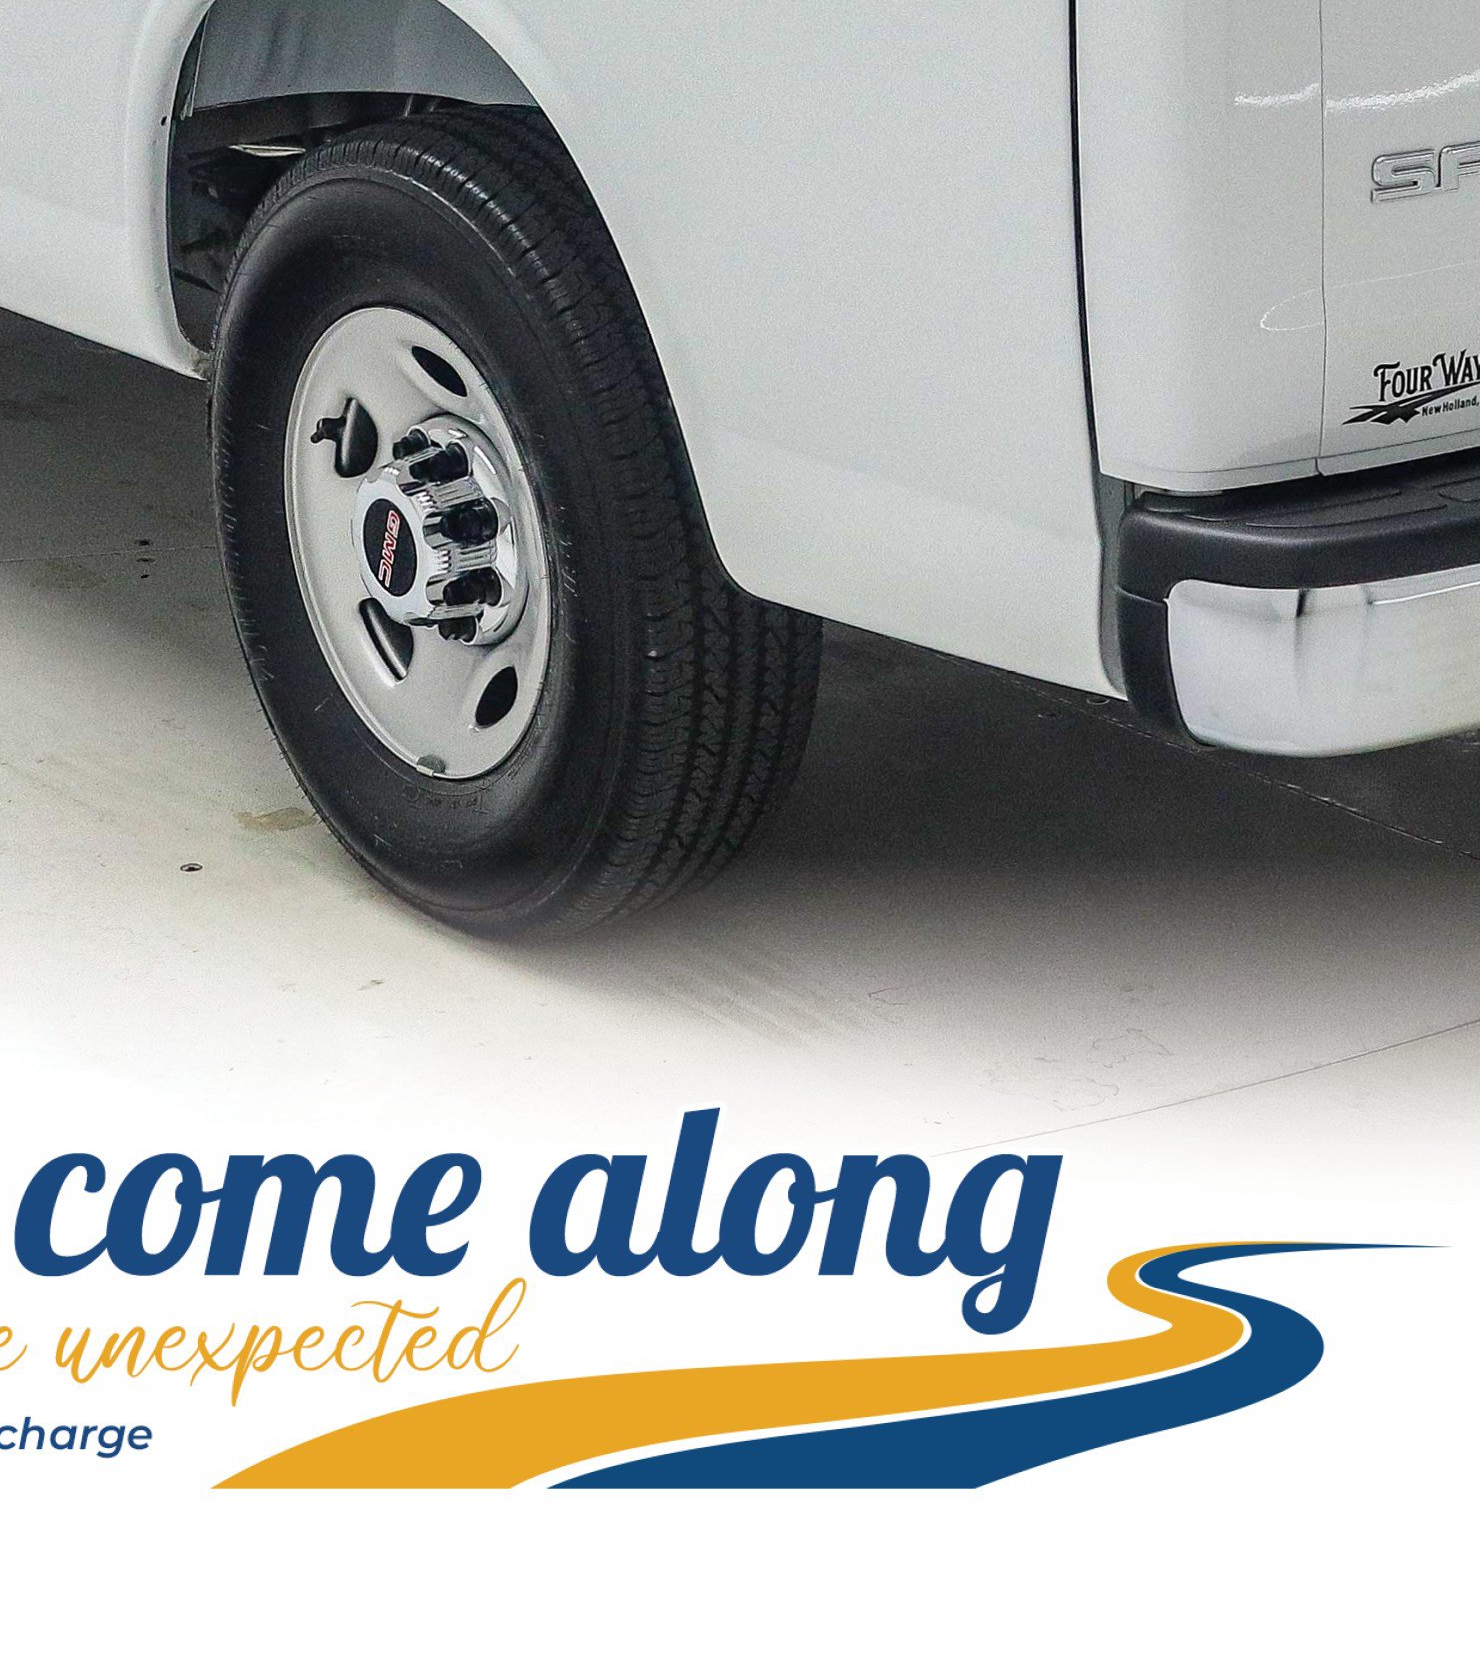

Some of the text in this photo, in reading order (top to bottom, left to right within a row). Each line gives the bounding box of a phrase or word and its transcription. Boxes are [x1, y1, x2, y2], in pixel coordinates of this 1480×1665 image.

[1373, 361, 1432, 402] FOUR
[1422, 406, 1441, 416] New
[1442, 395, 1479, 412] Holland,
[378, 510, 400, 588] GMC
